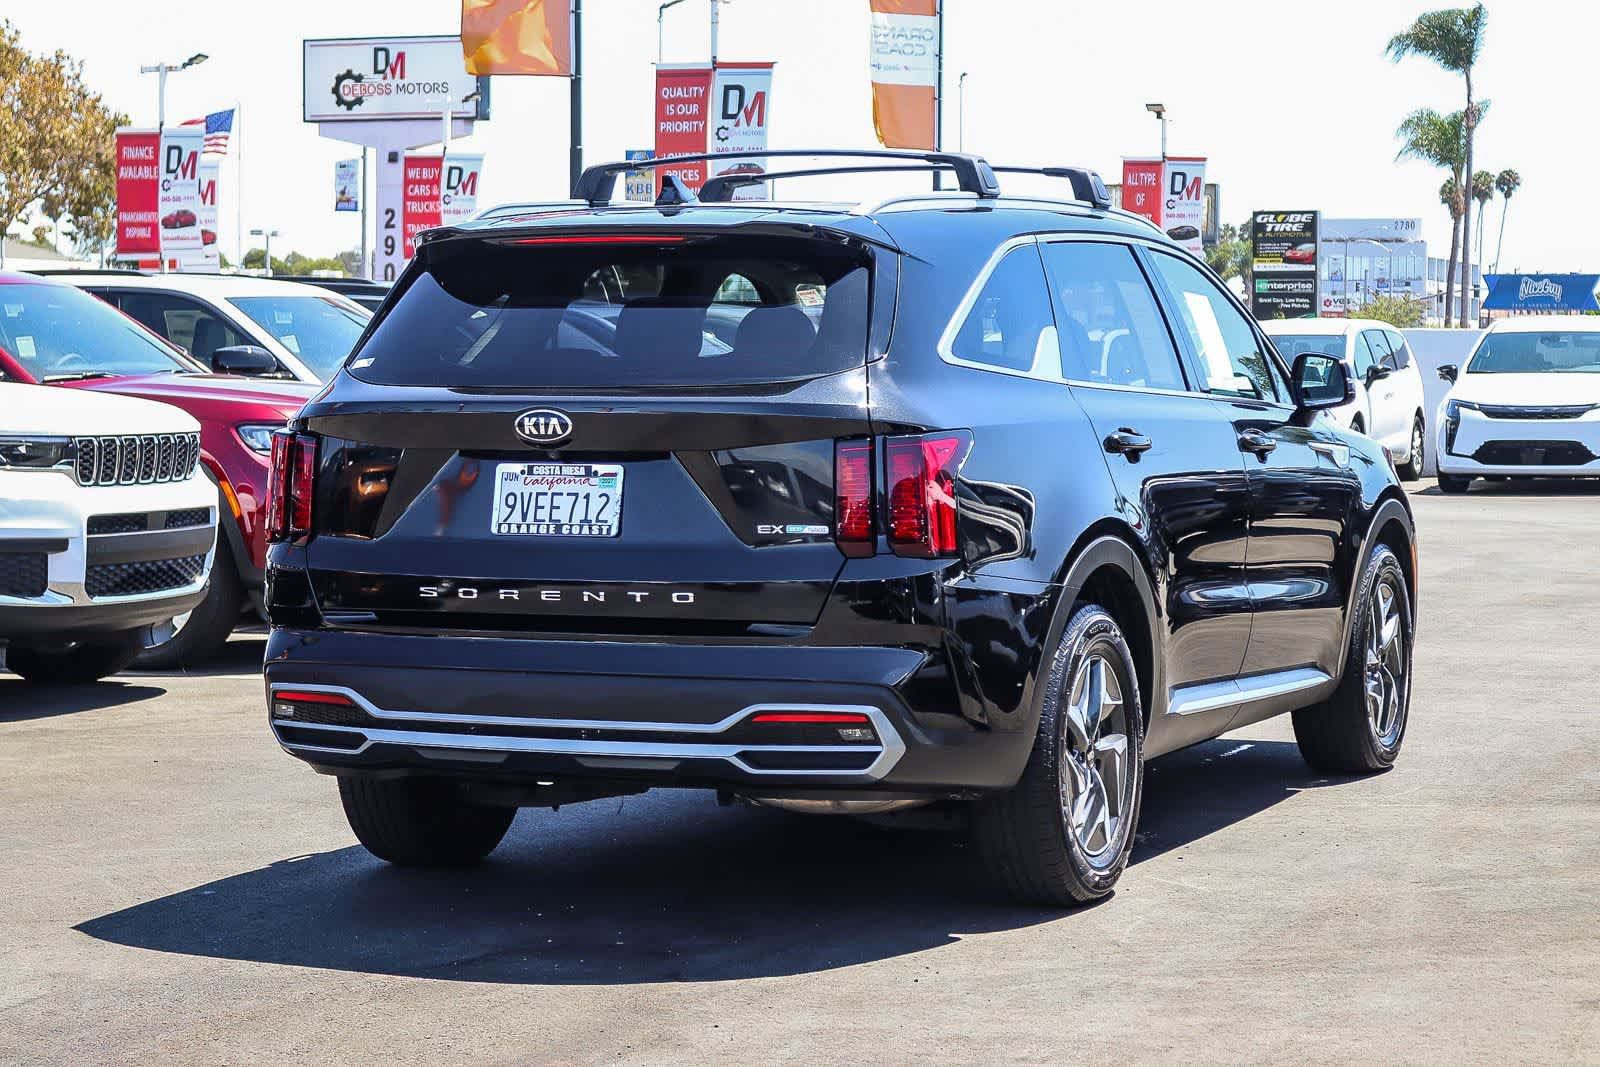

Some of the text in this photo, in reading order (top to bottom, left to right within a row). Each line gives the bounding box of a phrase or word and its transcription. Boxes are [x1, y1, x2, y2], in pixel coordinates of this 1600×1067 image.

[373, 47, 406, 80] DM
[342, 82, 449, 97] DEBOSS MOTORS
[662, 86, 705, 98] QUALITY
[666, 105, 699, 115] IS OUR
[722, 84, 766, 127] DM
[660, 121, 705, 133] PRIORITY
[122, 146, 155, 160] FINANCE
[166, 145, 198, 180] DM
[119, 164, 159, 179] AVAILABLE
[408, 167, 440, 179] WE BUY
[447, 166, 478, 196] DM
[1127, 172, 1156, 186] ALL TYPE
[408, 184, 440, 197] CARS &
[1170, 171, 1202, 201] DM
[1136, 193, 1145, 206] OF
[407, 200, 441, 213] TRUCKS
[1256, 214, 1314, 223] GLOBE
[1265, 223, 1305, 232] TIRE
[1395, 221, 1415, 230] 2780
[523, 417, 563, 435] KIA
[533, 466, 585, 475] COSTA MESA
[504, 473, 519, 482] JUN
[523, 476, 591, 490] California
[502, 491, 611, 523] 9VEE712
[500, 523, 610, 535] ORANGE COAST
[757, 525, 784, 534] EX
[419, 586, 695, 603] SORENTO
